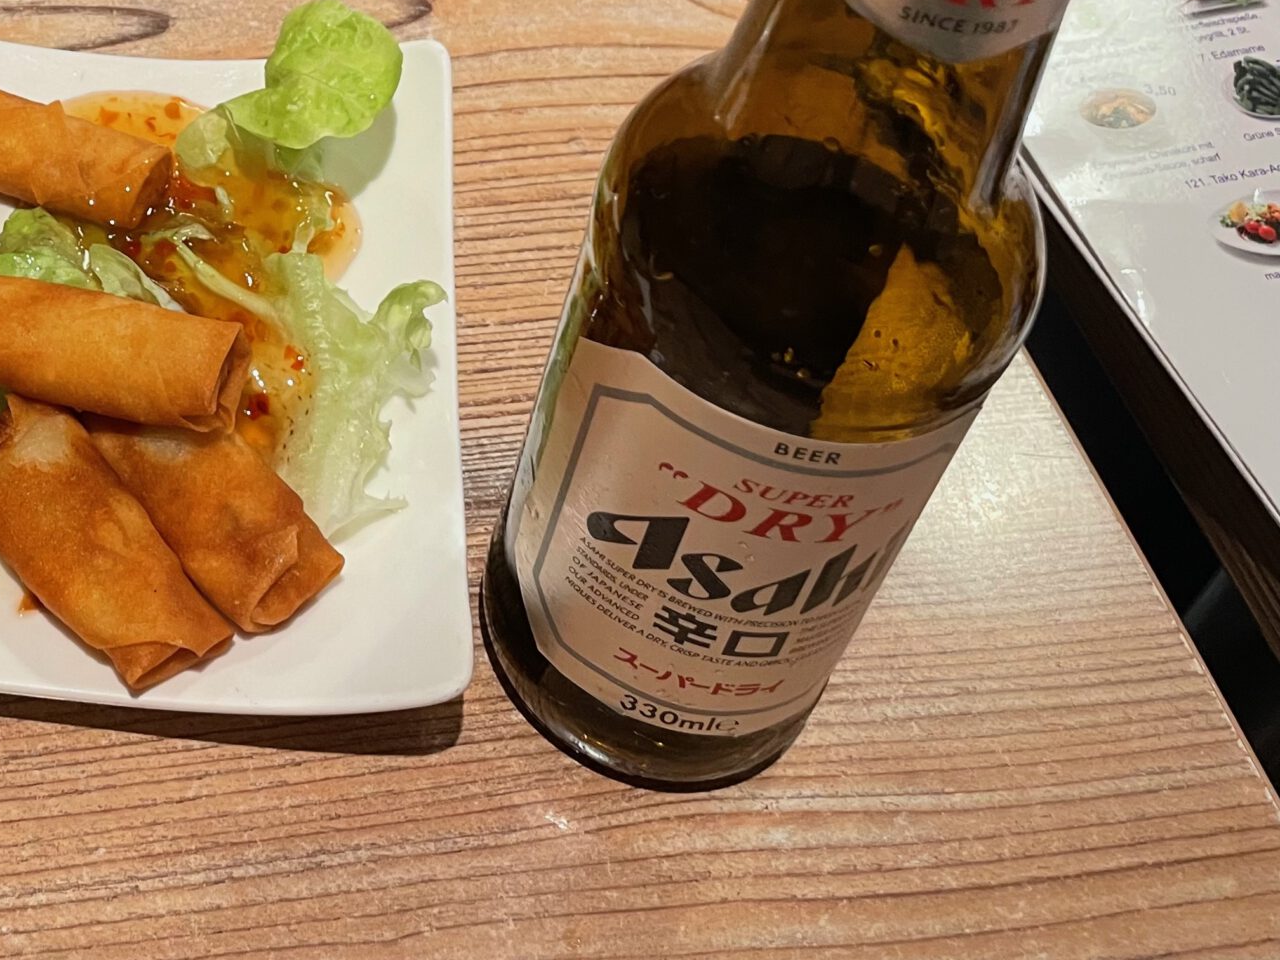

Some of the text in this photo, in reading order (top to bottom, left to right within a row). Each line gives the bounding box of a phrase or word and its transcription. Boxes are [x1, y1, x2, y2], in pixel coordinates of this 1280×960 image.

[898, 6, 968, 34] SINCE
[1211, 173, 1238, 186] Tako
[773, 442, 842, 466] BEER
[734, 478, 855, 509] SUPER
[568, 566, 640, 620] OUR ADVANCED
[572, 556, 644, 610] OF JAPANESE
[606, 559, 637, 582] SUPER
[636, 578, 657, 593] DRY
[668, 595, 713, 619] BREWED
[714, 614, 743, 626] WITH
[619, 581, 649, 602] UNDER
[565, 576, 596, 606] NIQUES
[596, 603, 637, 632] DELIVER
[669, 644, 700, 658] CRISP
[701, 655, 732, 666] TASTE
[652, 605, 791, 657] 辛口
[613, 646, 786, 696] スーパードライ
